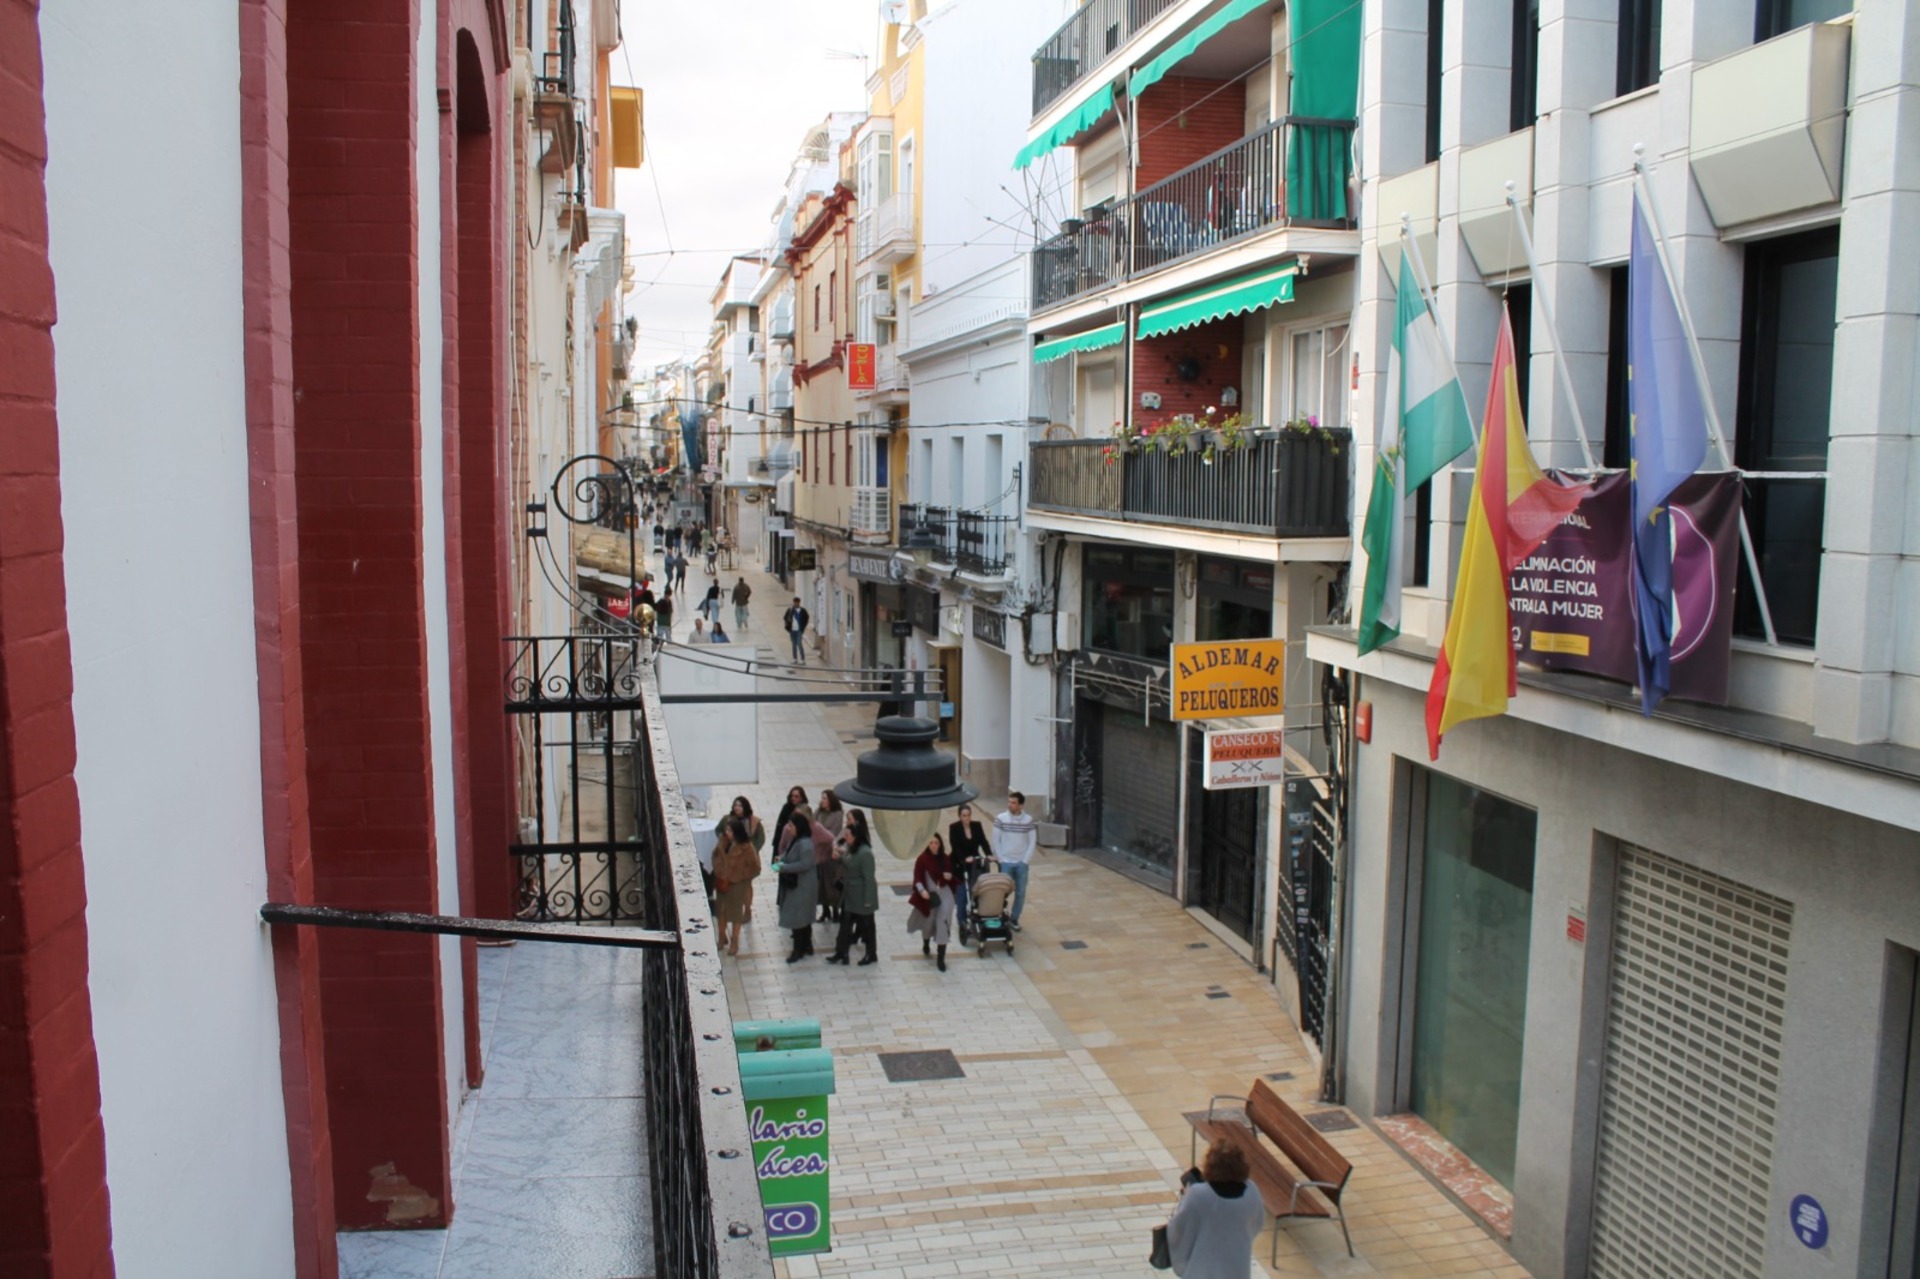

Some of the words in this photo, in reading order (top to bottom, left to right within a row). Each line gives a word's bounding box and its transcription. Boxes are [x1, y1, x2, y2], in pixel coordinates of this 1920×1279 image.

[1511, 577, 1529, 591] LA
[1530, 578, 1598, 597] VIOLENCIA
[1552, 601, 1603, 620] MUJER
[1179, 648, 1279, 679] ALDEMAR
[1180, 686, 1279, 711] PELUQUEROS
[766, 1210, 806, 1231] CO
